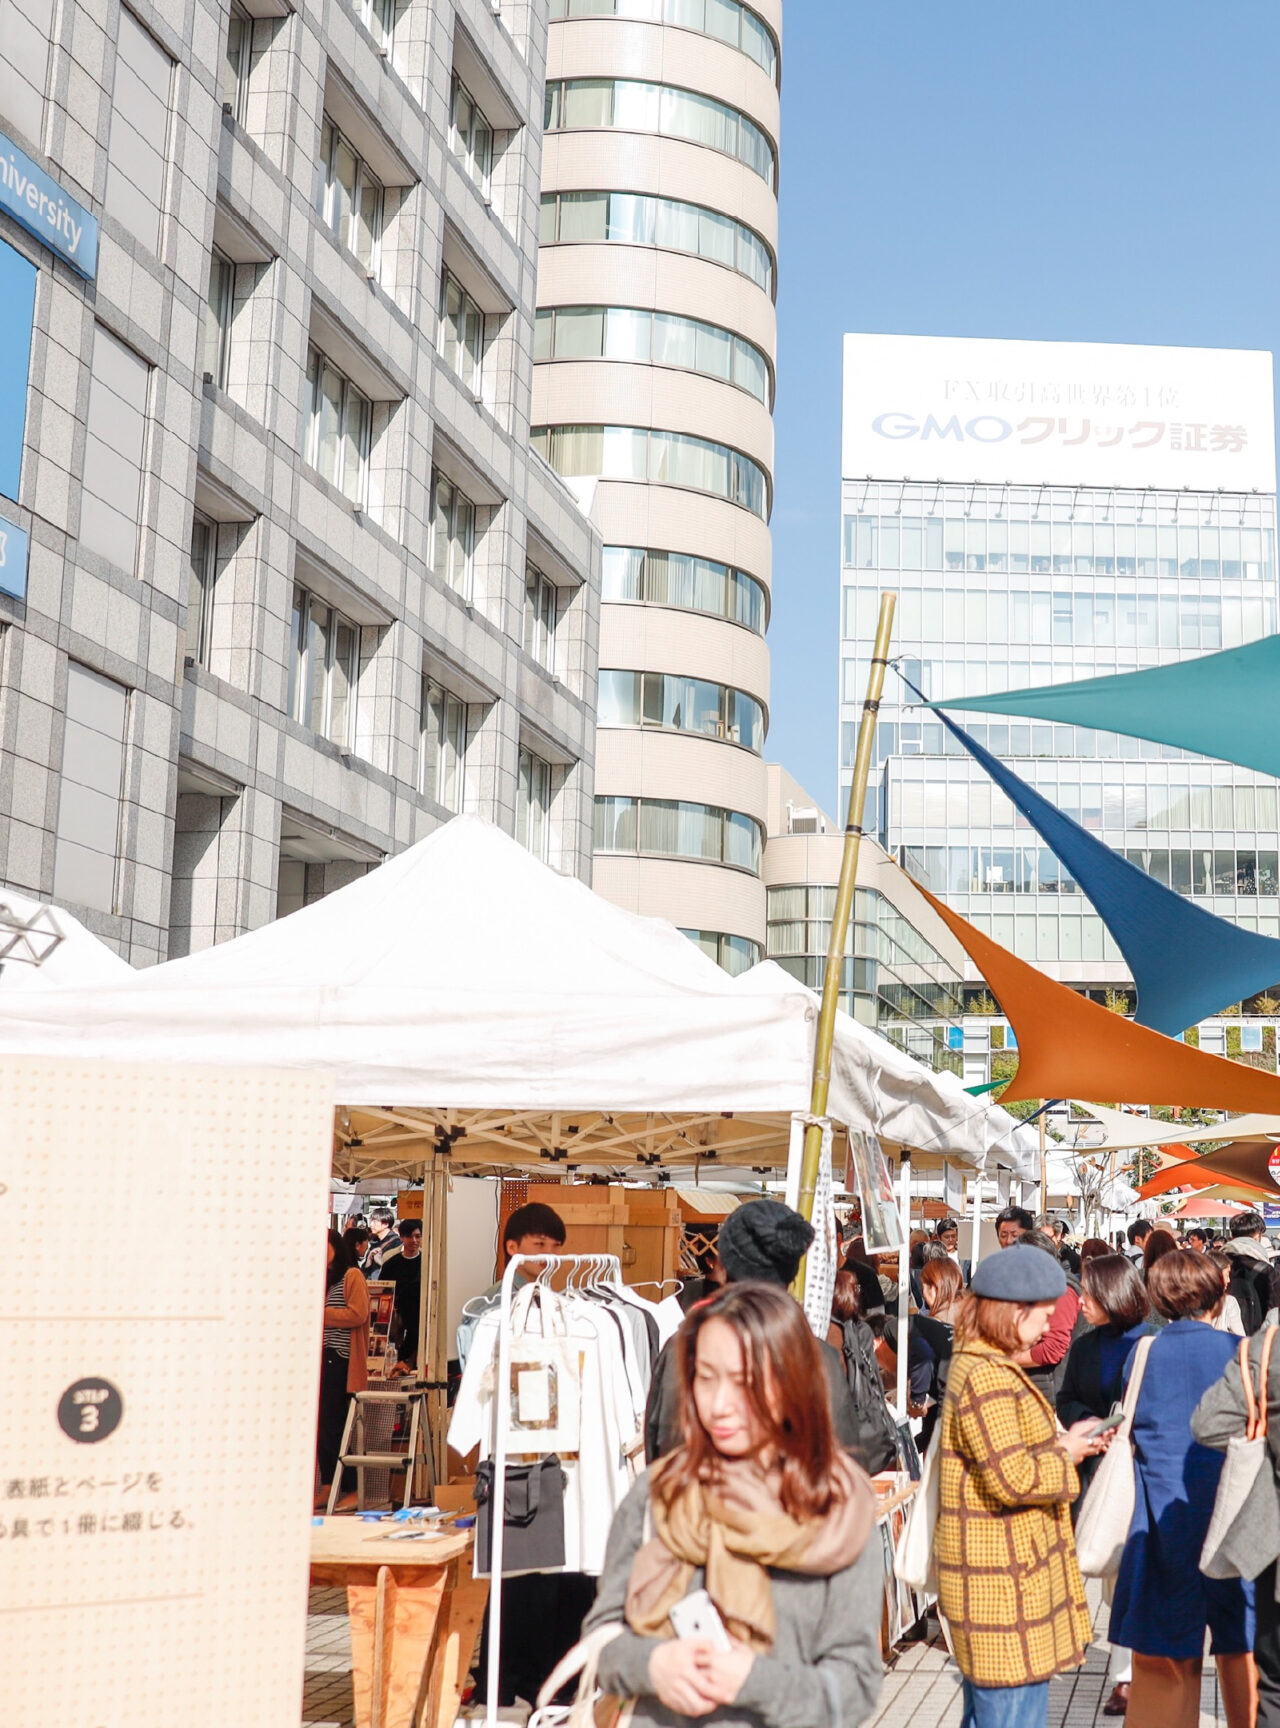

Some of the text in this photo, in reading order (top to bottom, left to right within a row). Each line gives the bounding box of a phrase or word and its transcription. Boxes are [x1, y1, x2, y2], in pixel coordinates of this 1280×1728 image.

[871, 411, 1249, 453] GMOクリック証券
[72, 1388, 109, 1405] STEP
[79, 1405, 100, 1432] 3
